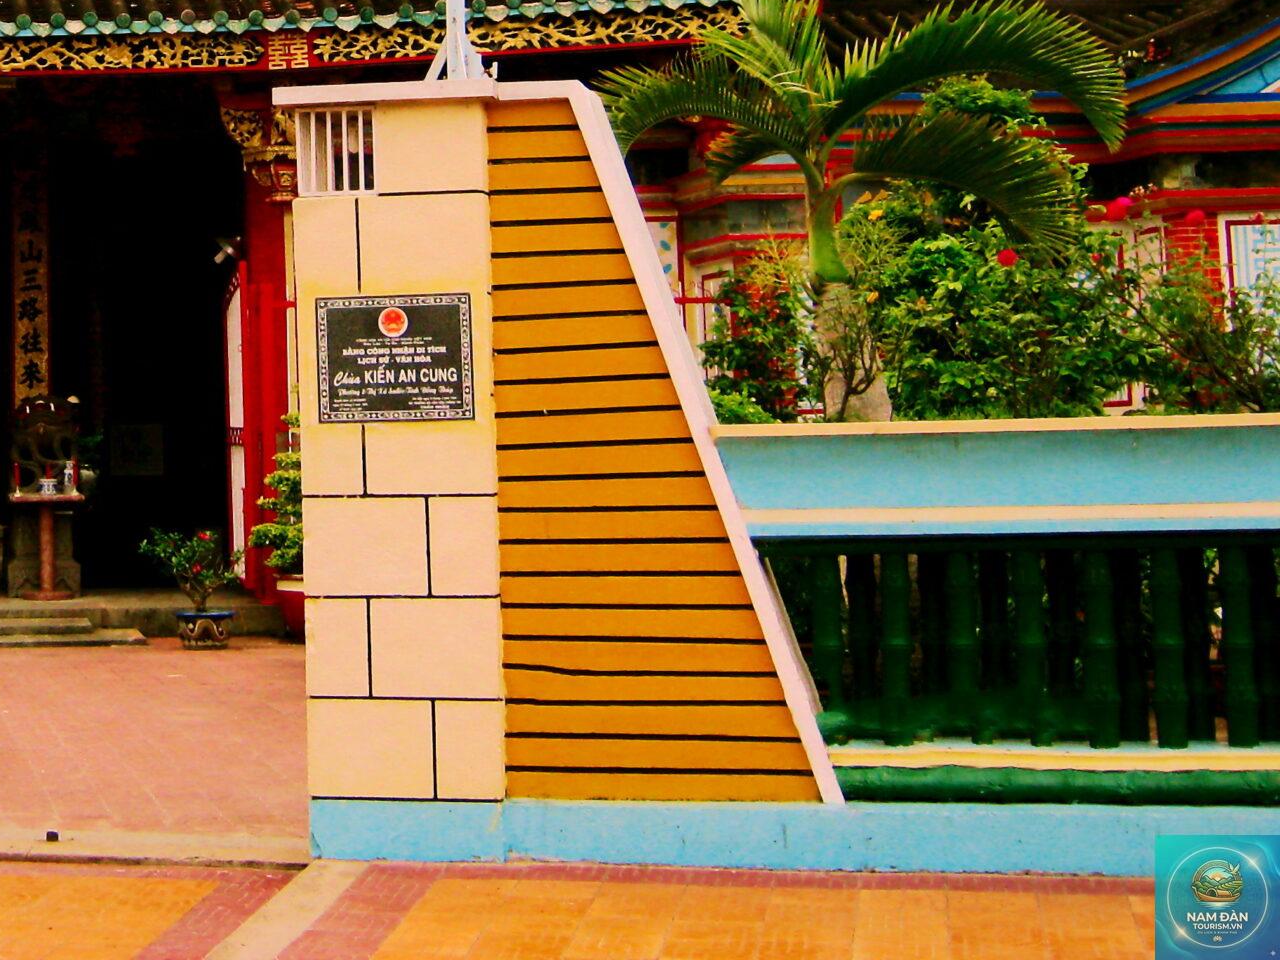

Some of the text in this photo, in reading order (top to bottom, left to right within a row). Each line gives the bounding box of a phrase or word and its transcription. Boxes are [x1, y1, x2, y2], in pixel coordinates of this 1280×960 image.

[364, 364, 395, 384] KIẾN
[398, 369, 417, 383] AN
[420, 367, 458, 383] CUNG
